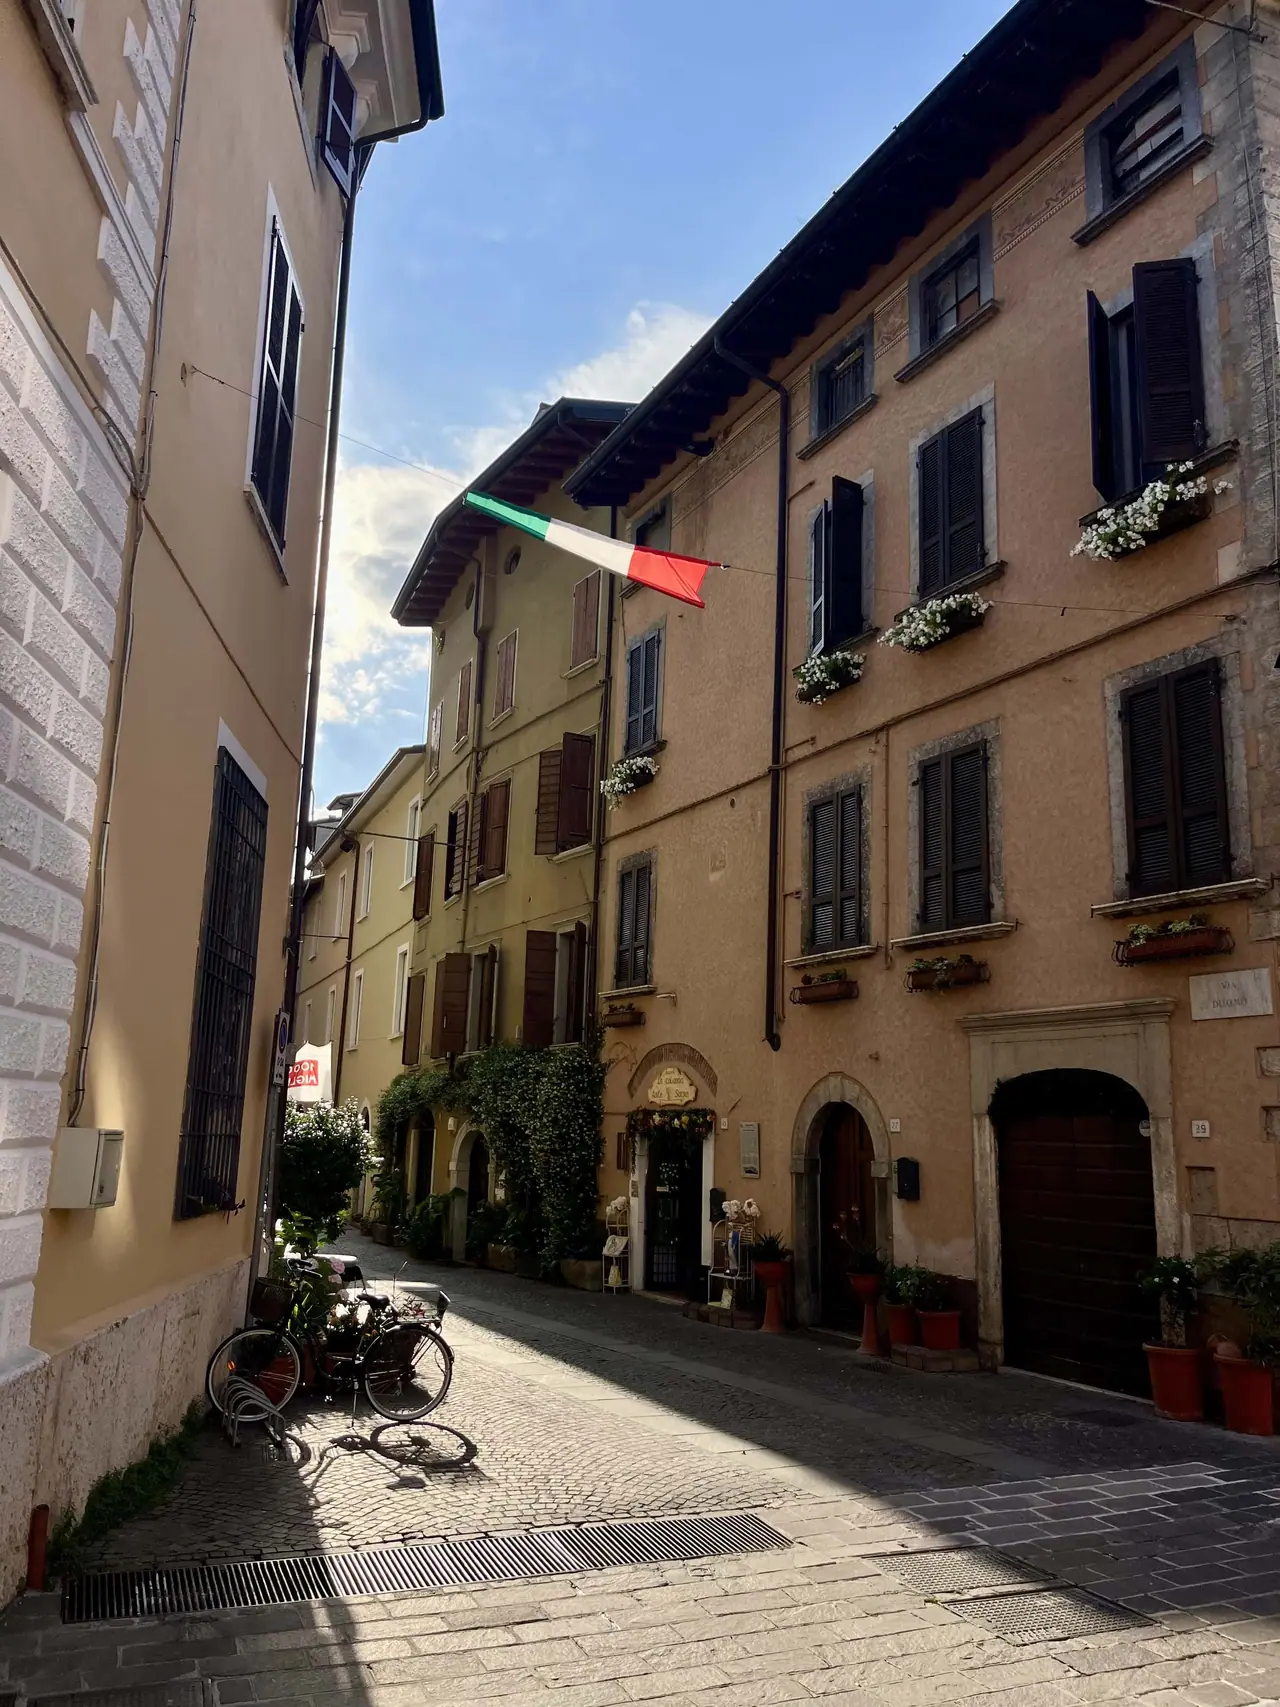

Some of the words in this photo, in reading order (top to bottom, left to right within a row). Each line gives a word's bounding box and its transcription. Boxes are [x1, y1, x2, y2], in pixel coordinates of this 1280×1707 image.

[1221, 981, 1237, 989] VIA
[1212, 997, 1248, 1009] DUOMO
[1196, 1124, 1207, 1134] 29
